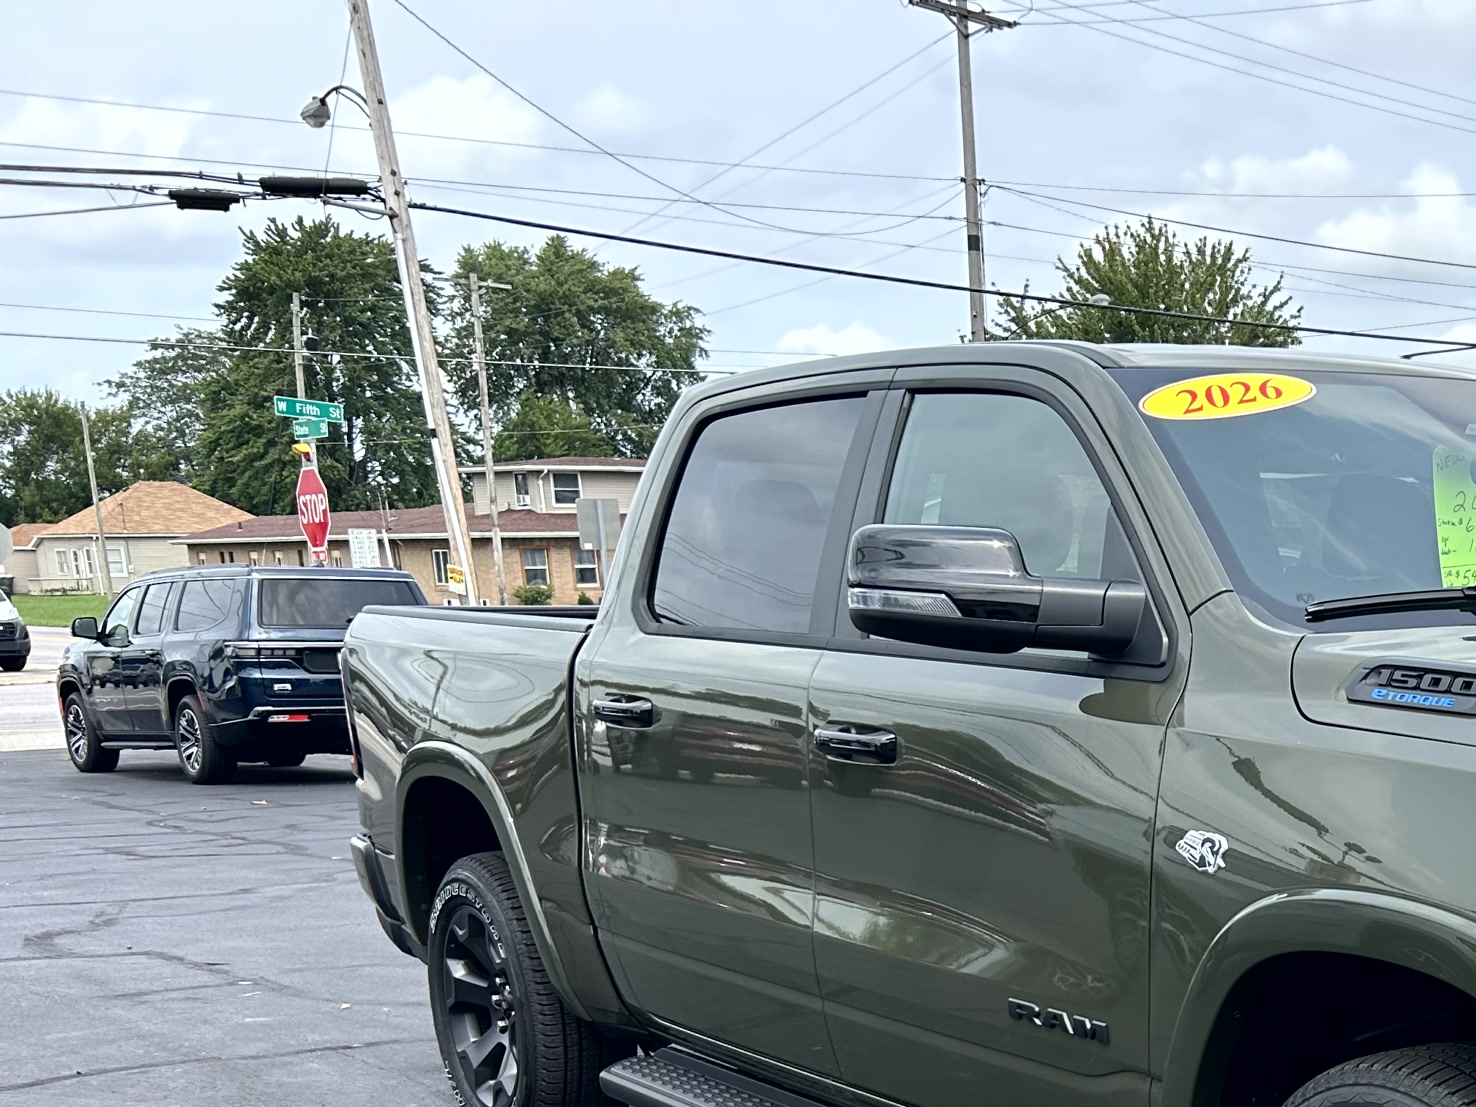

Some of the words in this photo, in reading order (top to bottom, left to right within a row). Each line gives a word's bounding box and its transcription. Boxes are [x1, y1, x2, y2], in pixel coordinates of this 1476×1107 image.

[277, 401, 287, 411] W
[296, 403, 320, 416] Fifth
[329, 407, 341, 418] St
[1175, 378, 1283, 415] 2026
[299, 493, 326, 524] STOP
[1008, 997, 1110, 1046] RAM
